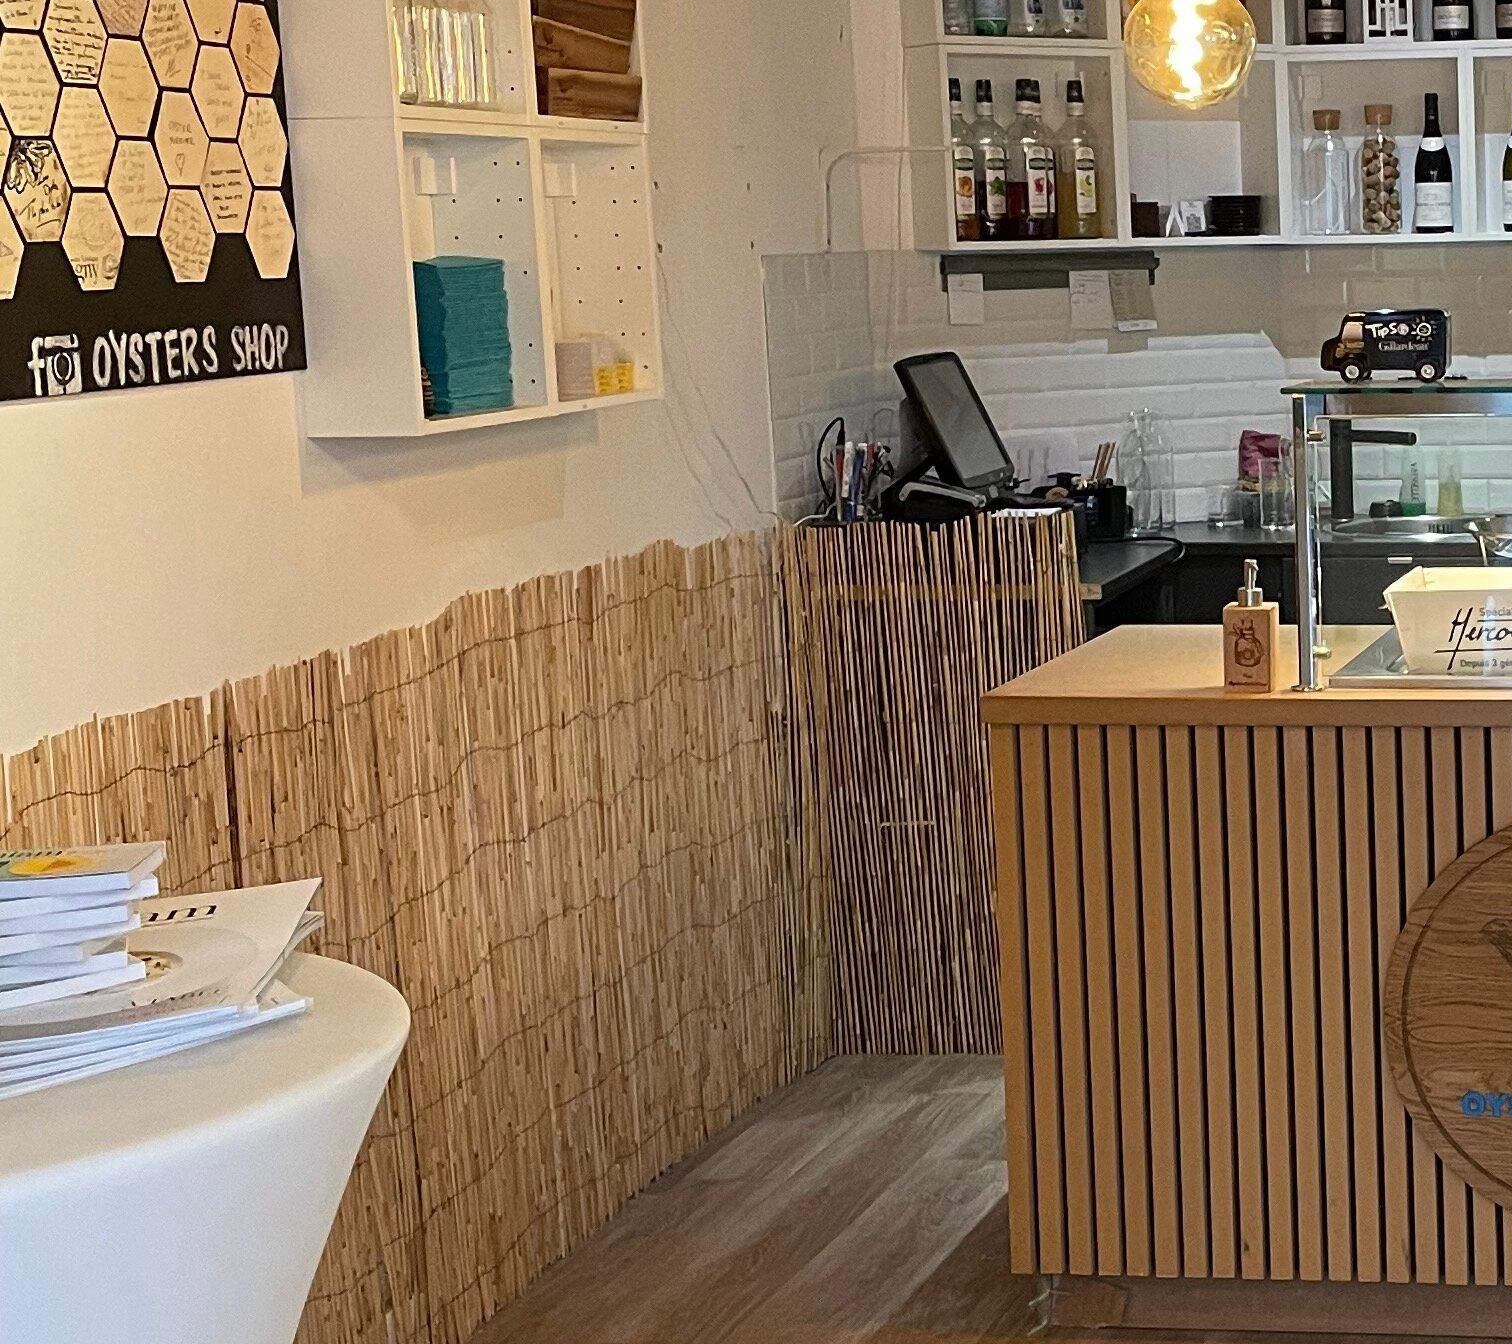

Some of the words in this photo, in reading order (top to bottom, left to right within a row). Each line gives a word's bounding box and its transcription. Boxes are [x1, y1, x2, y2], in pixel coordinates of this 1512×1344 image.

[92, 325, 219, 388] OYSTERS
[230, 323, 289, 372] SHOP
[1460, 659, 1490, 669] Depuis
